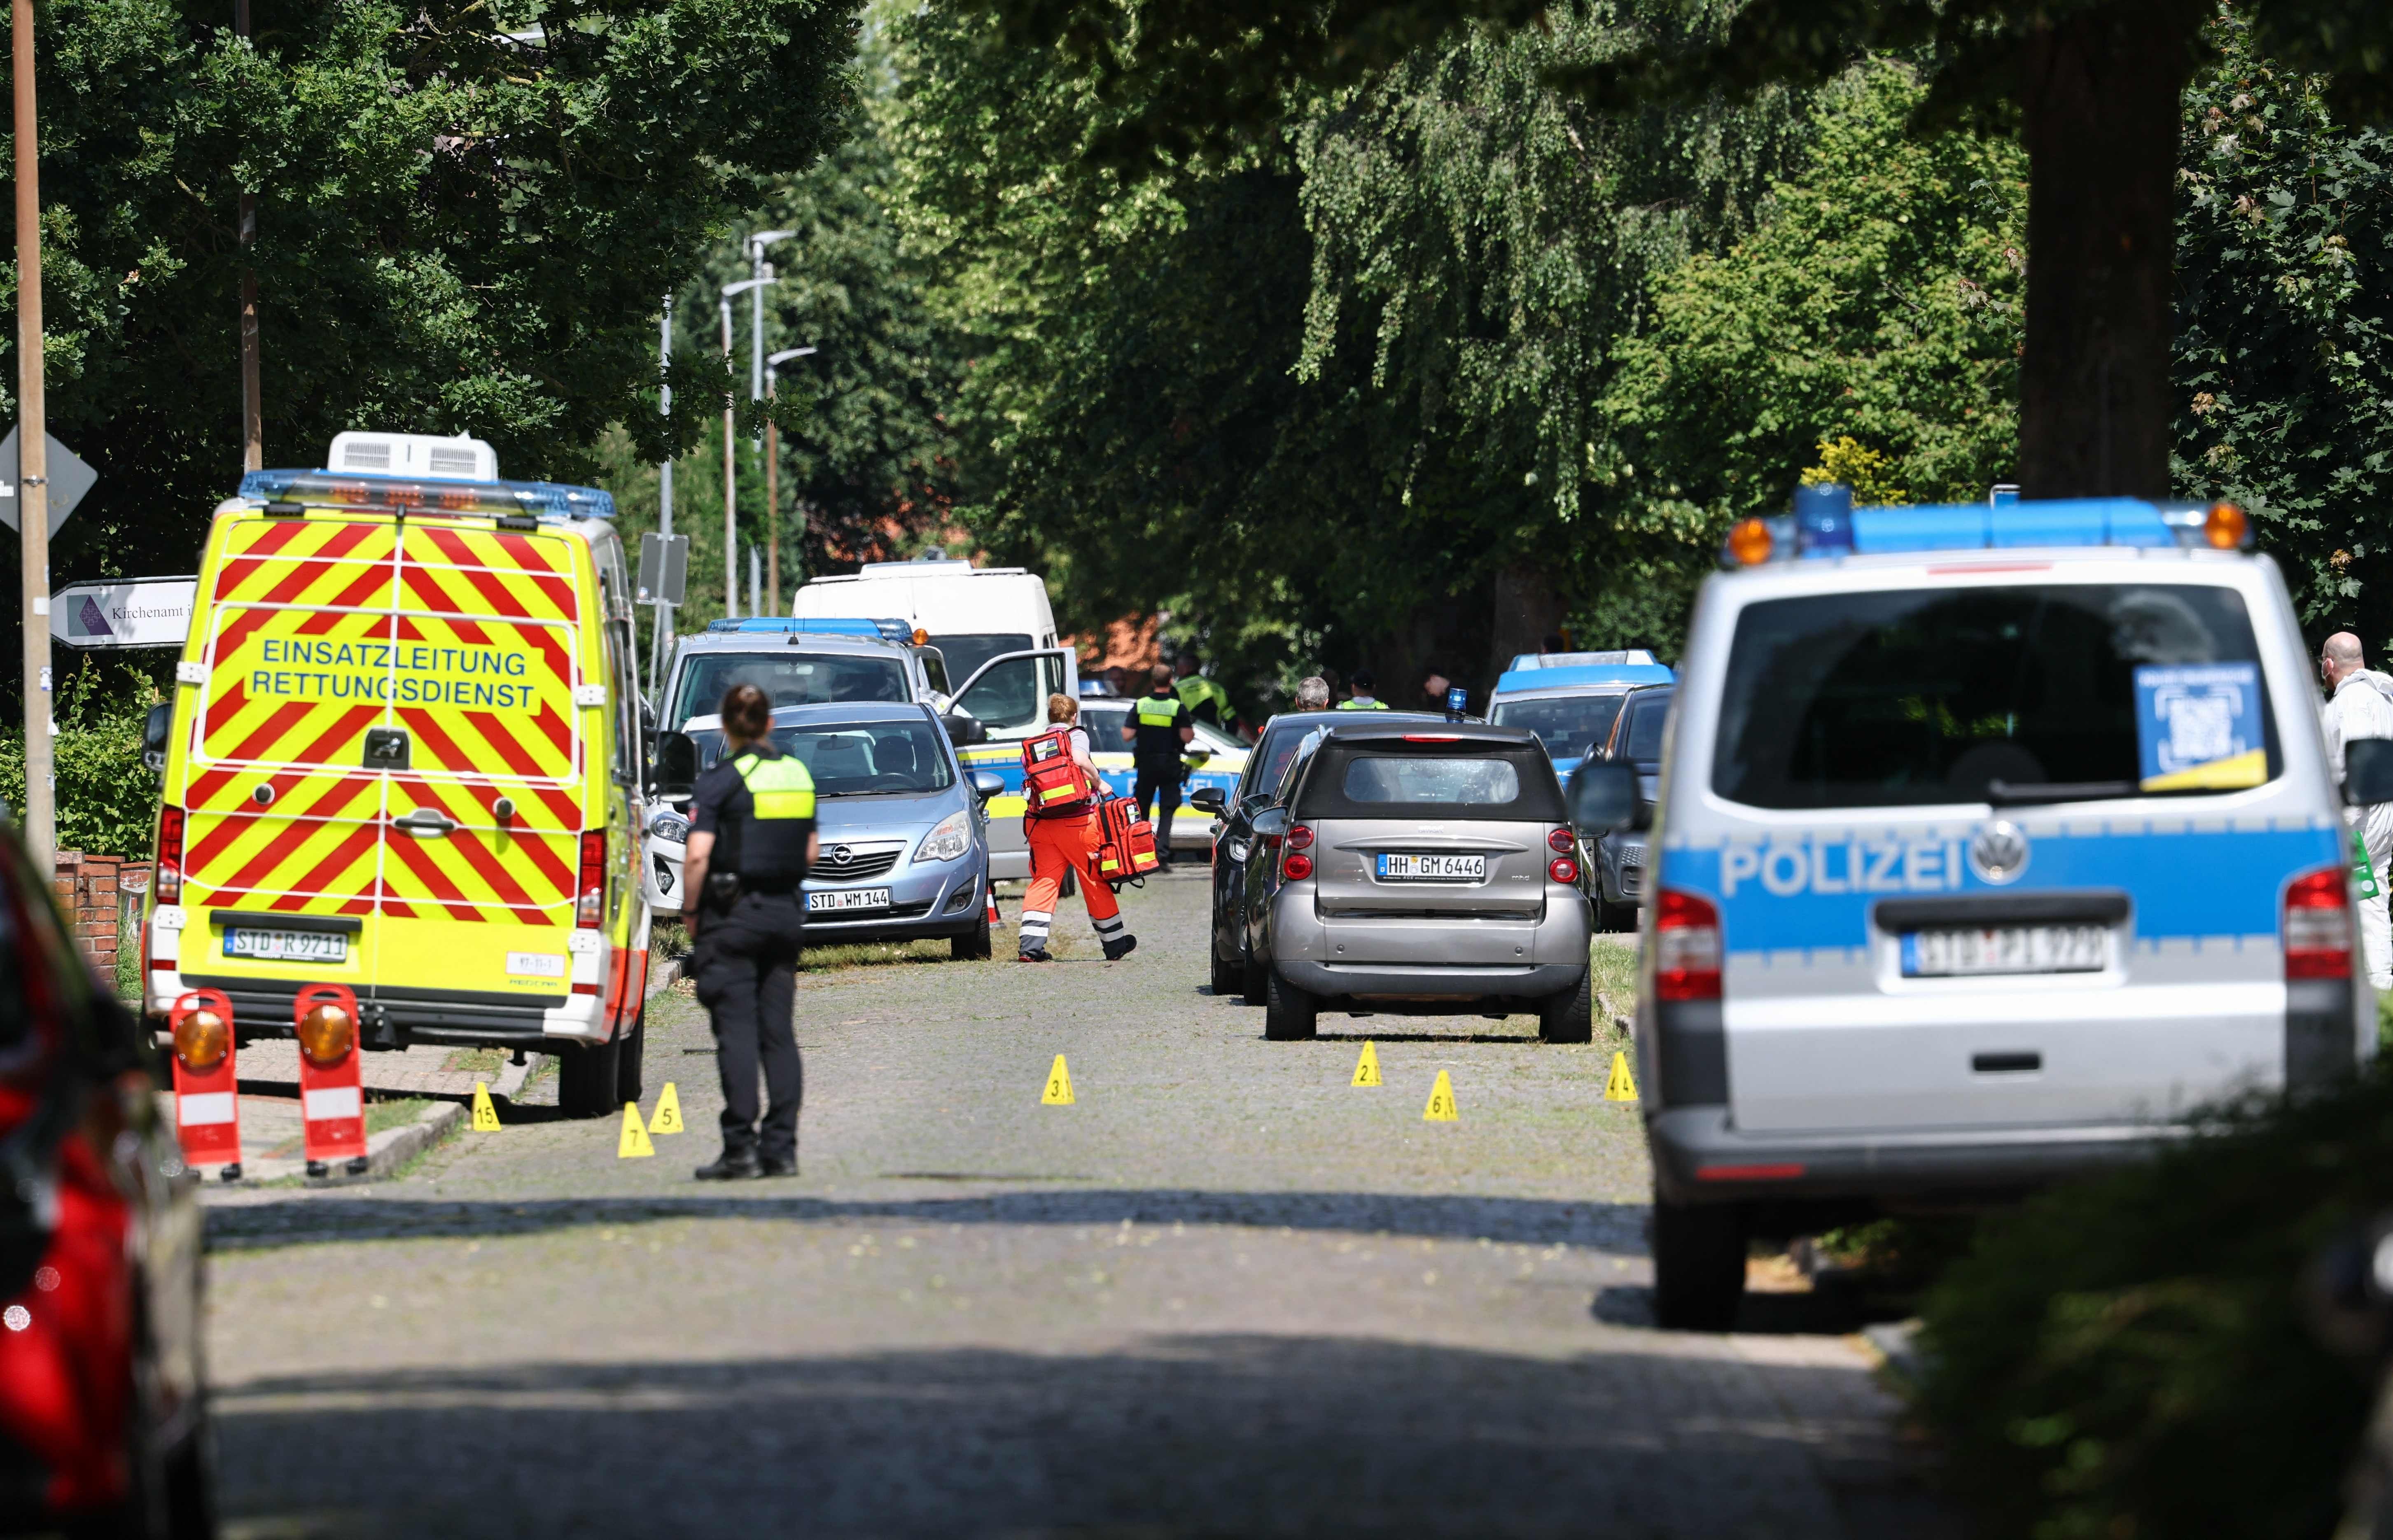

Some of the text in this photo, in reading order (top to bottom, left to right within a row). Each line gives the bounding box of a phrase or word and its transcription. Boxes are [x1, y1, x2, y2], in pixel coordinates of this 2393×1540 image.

[112, 606, 184, 619] Kirchenamt
[263, 639, 525, 676] EINSATZLEITUNG
[252, 670, 535, 708] RETTUNGSDIENST
[1143, 702, 1172, 714] POLIZEI
[1389, 857, 1408, 873] HH
[1421, 857, 1440, 874] GM
[1445, 858, 1482, 874] 6446
[1721, 840, 1961, 898] POLIZEI
[811, 894, 835, 908] STD
[845, 893, 861, 906] WM
[865, 891, 887, 905] 144
[237, 931, 270, 951] STD
[285, 933, 294, 952] R
[301, 934, 343, 955] 9711
[1360, 1065, 1368, 1081] 2
[1051, 1079, 1059, 1097] 3
[1433, 1096, 1441, 1113] 6
[476, 1106, 493, 1124] 15
[663, 1108, 672, 1126] 5
[629, 1129, 639, 1147] 7
